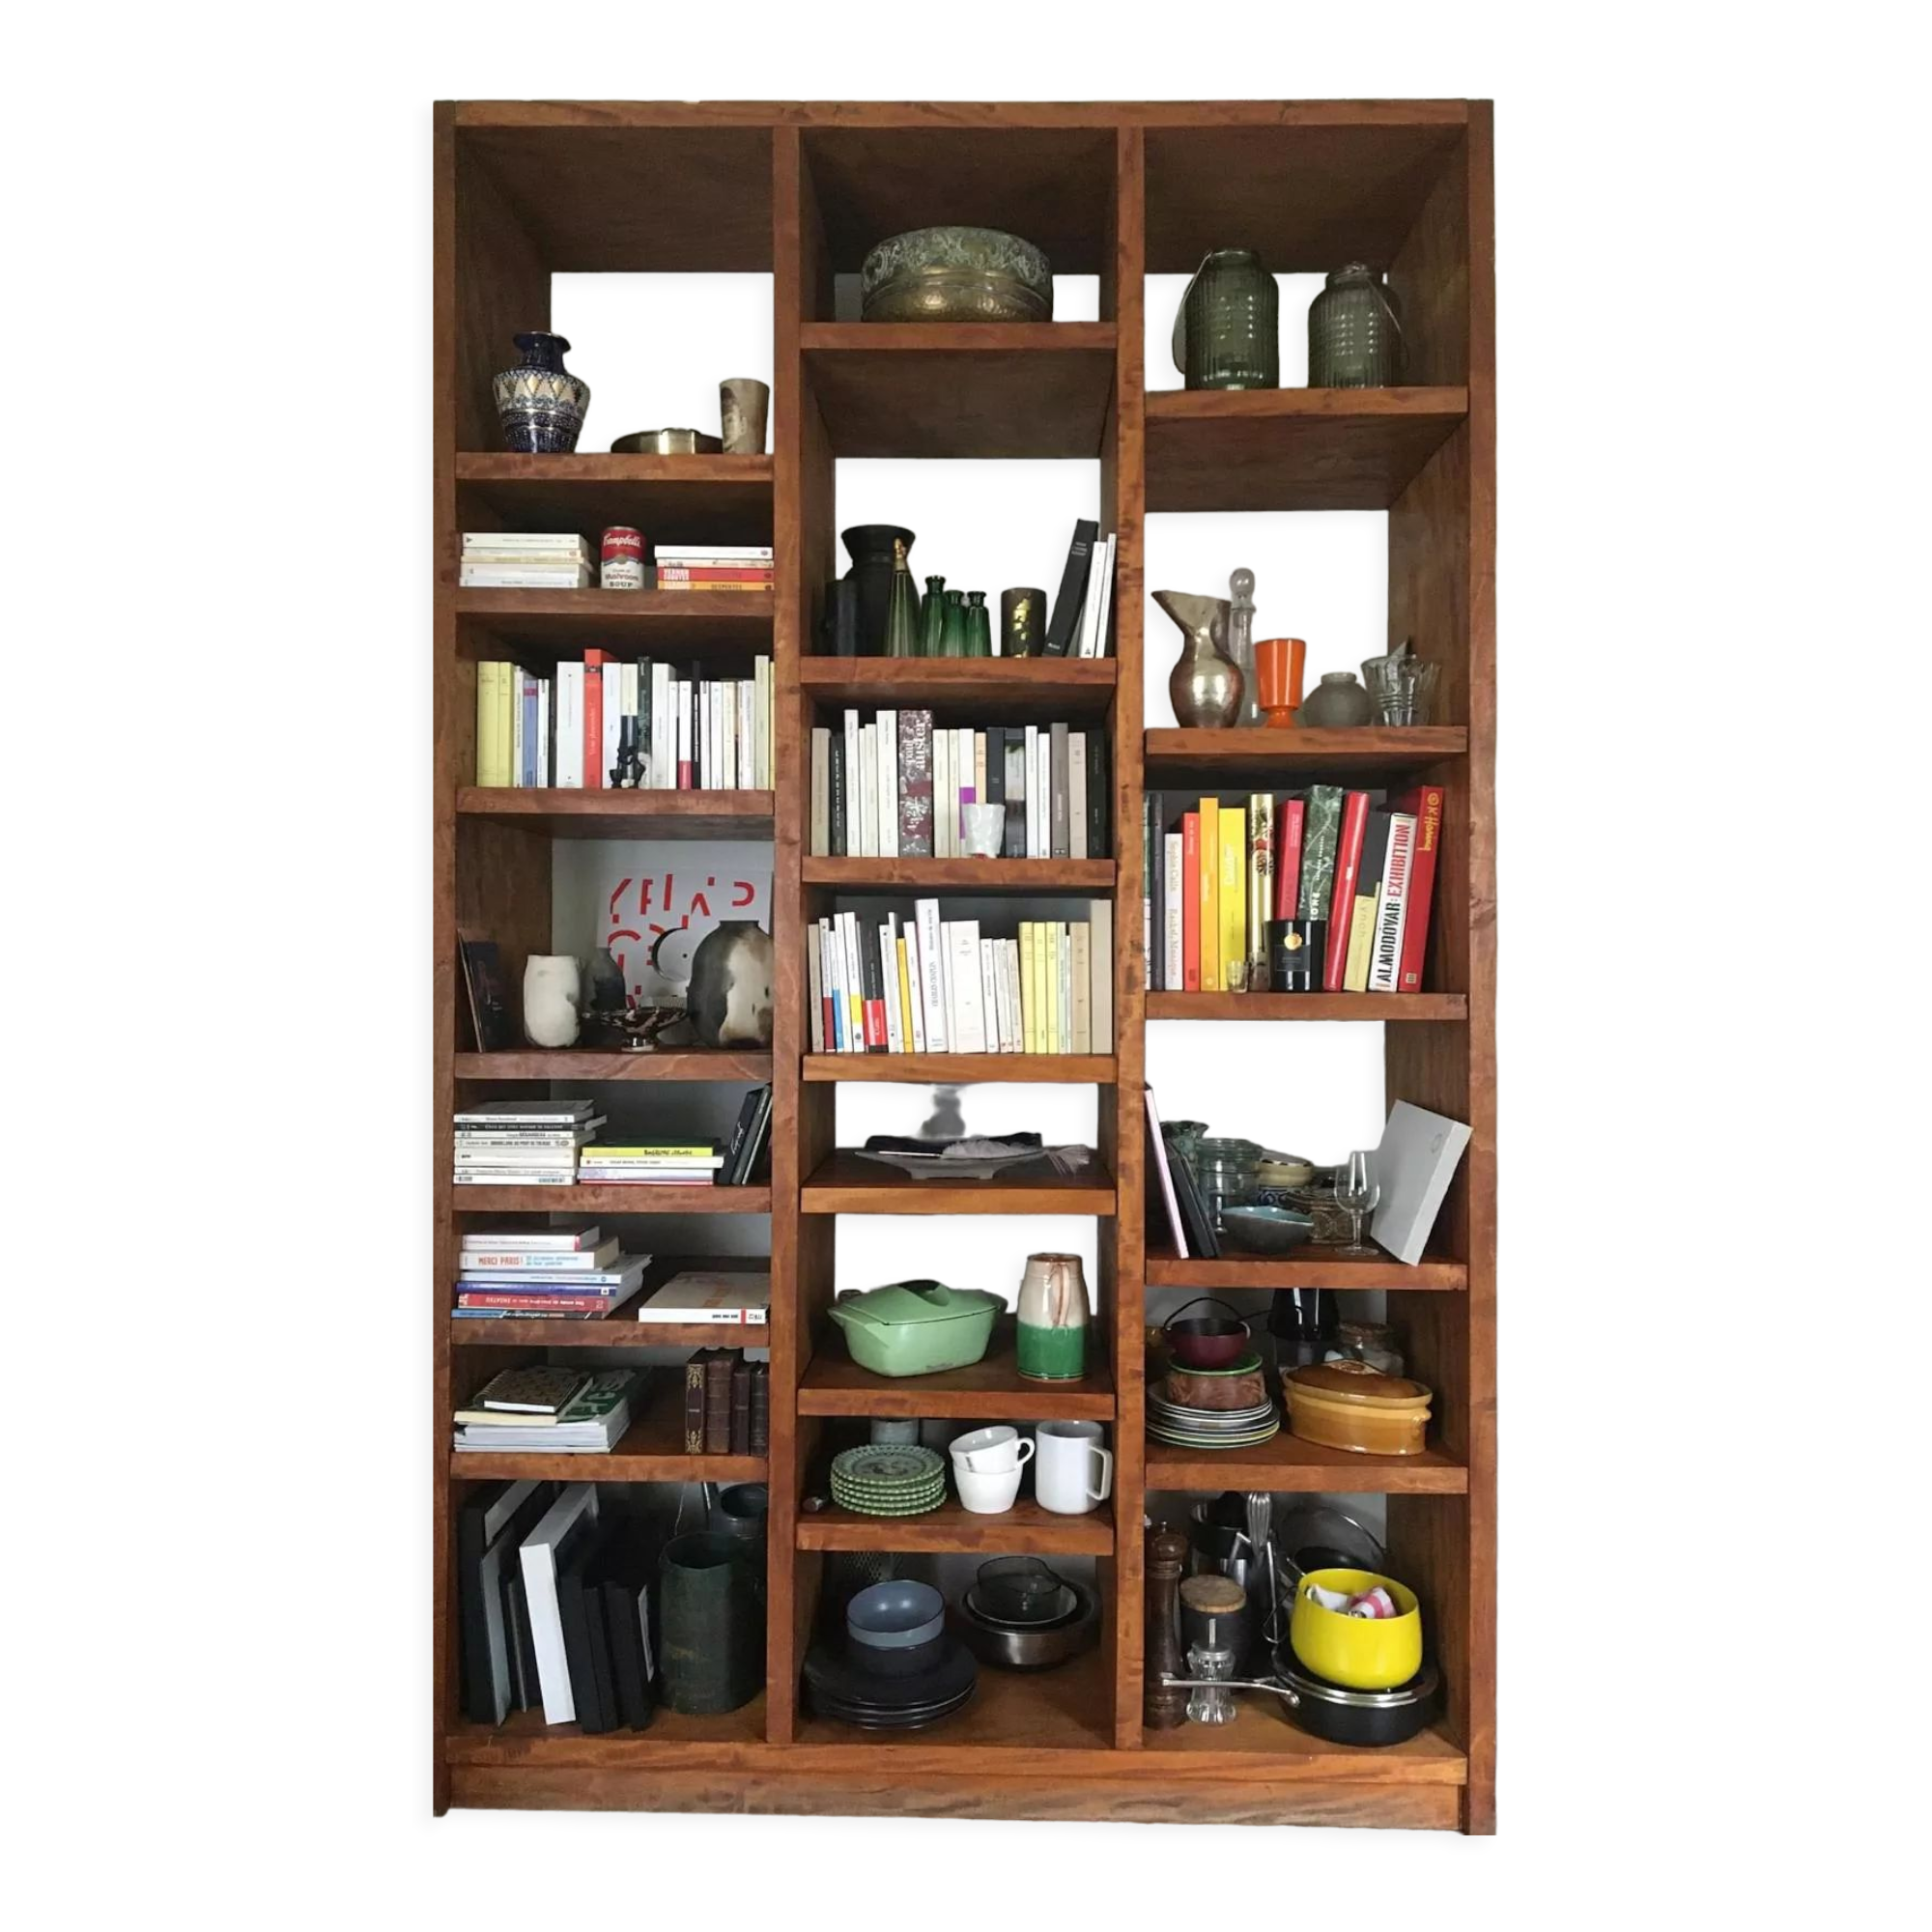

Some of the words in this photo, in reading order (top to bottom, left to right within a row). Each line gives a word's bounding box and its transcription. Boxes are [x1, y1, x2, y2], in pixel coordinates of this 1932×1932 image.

[904, 738, 915, 764] paul
[913, 719, 926, 770] auster
[1387, 824, 1410, 897] EXHIBITION
[1358, 898, 1371, 938] Lynch
[478, 1257, 497, 1265] MERCI
